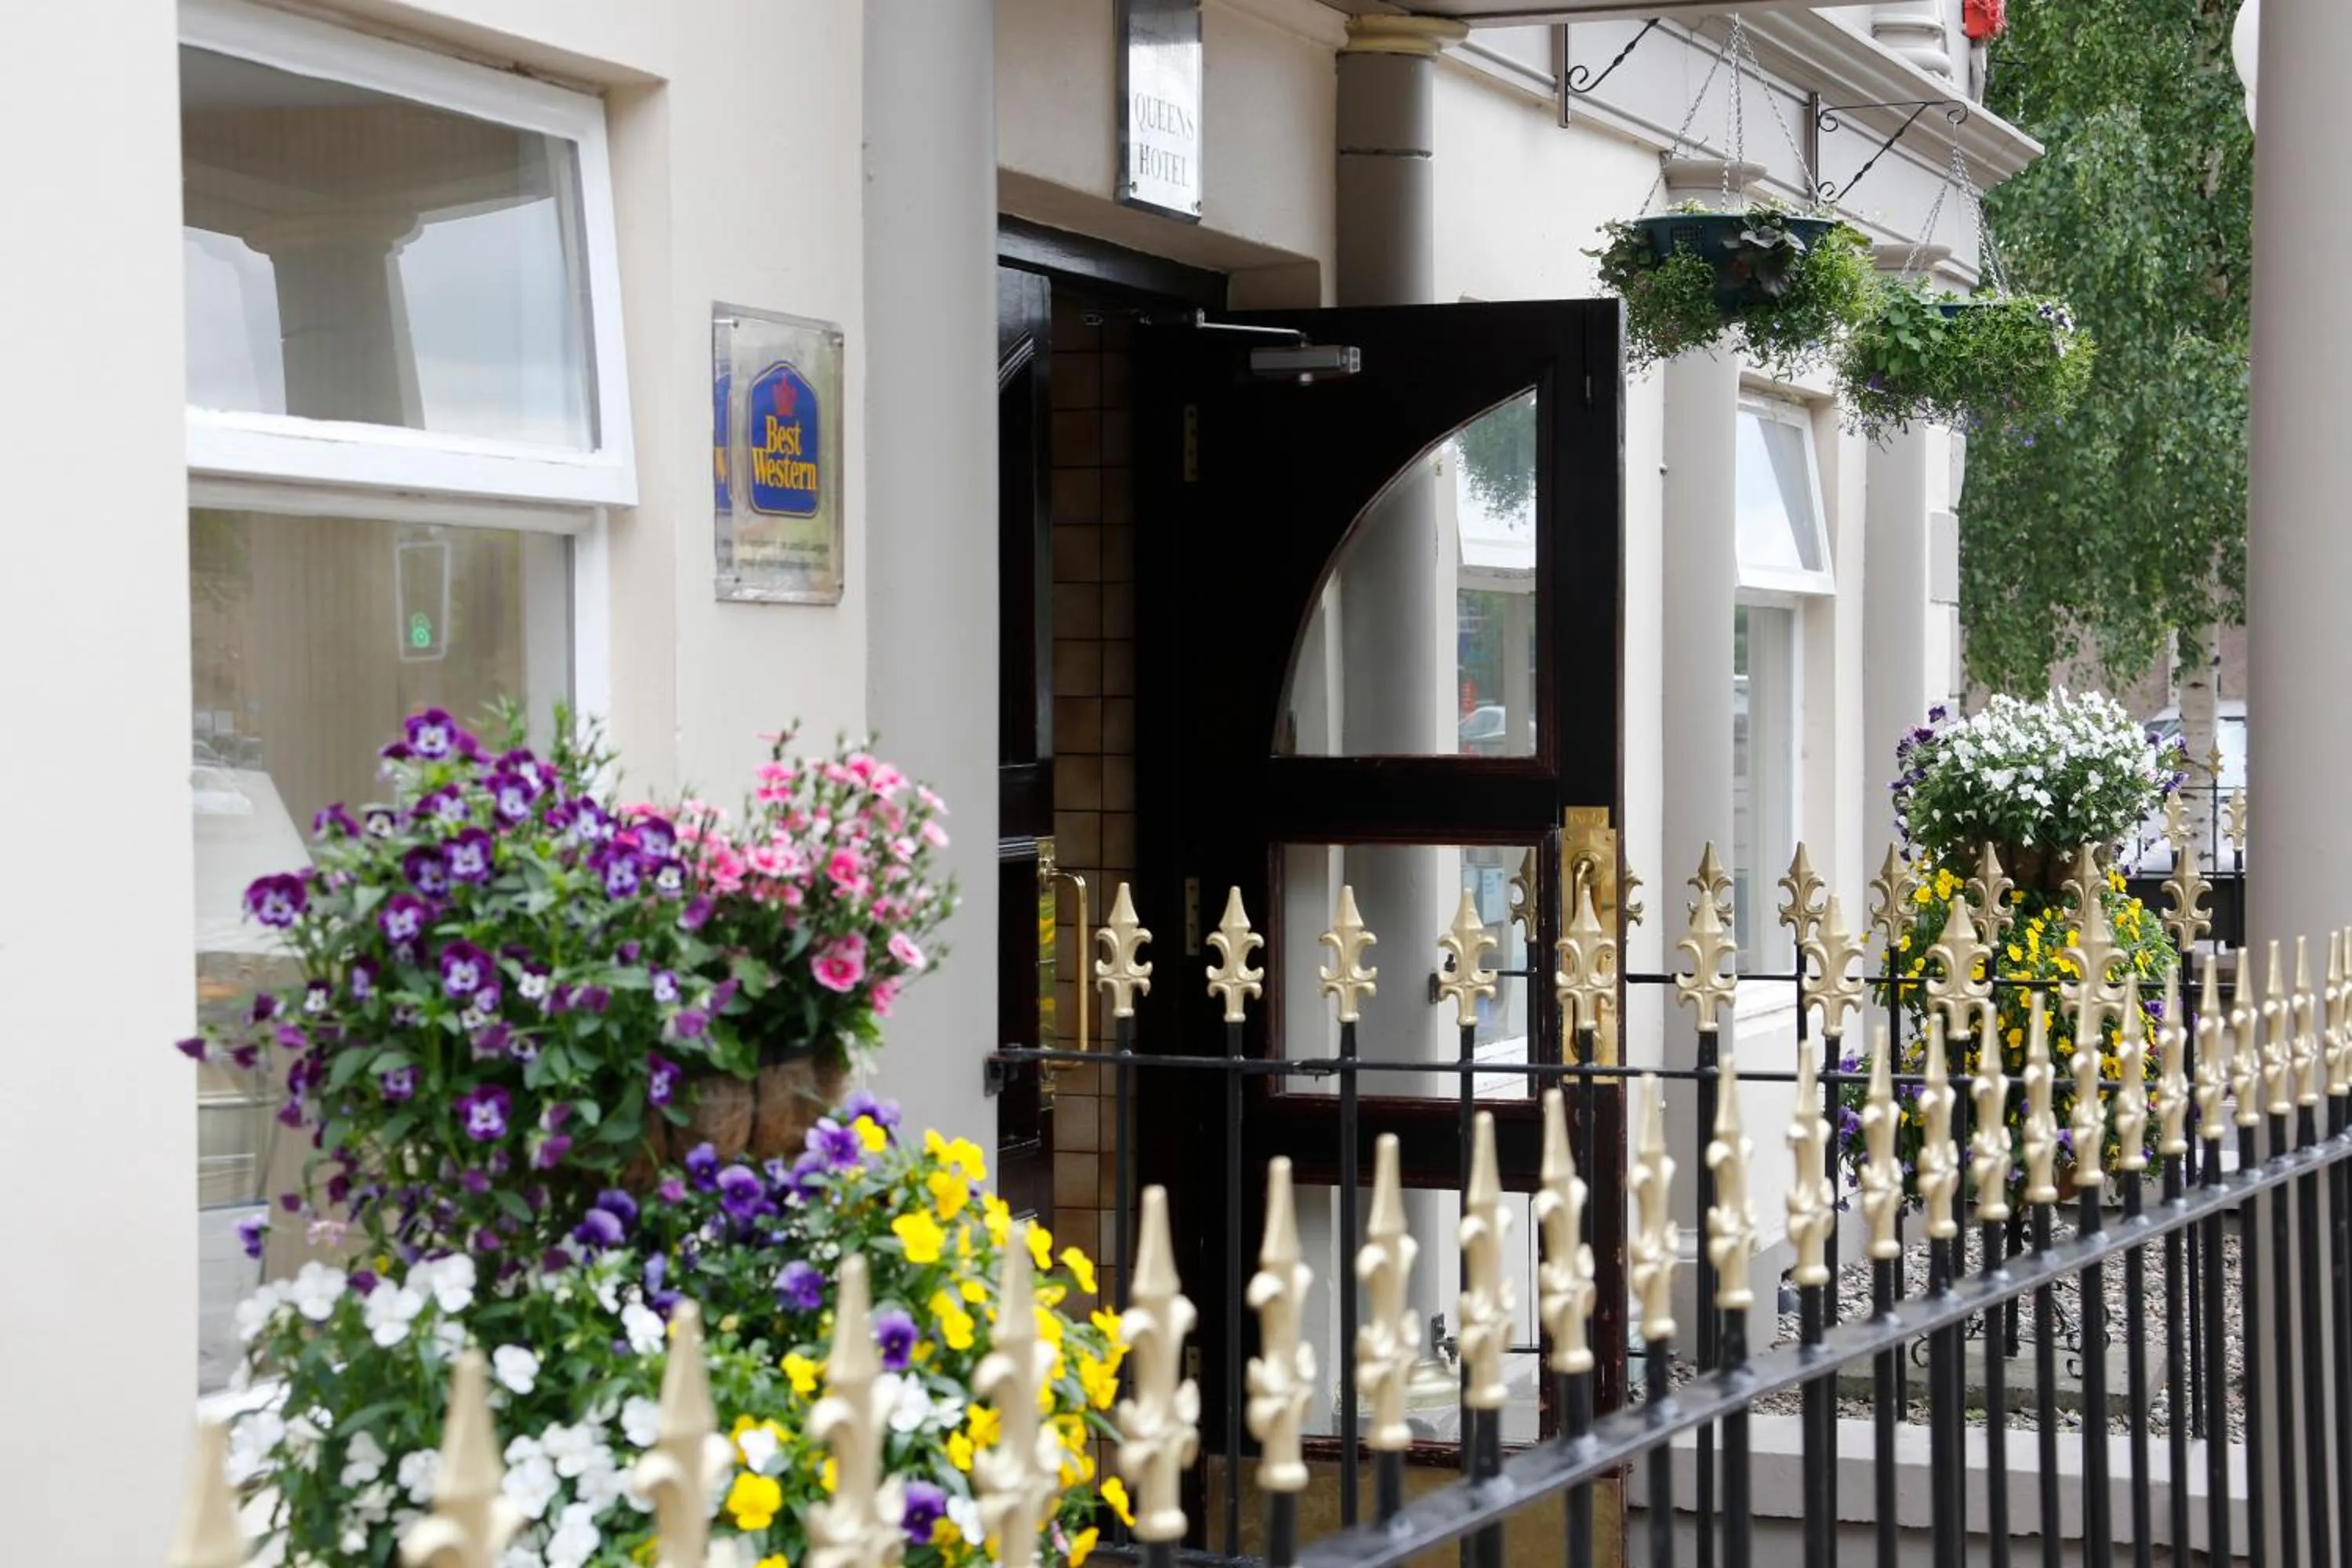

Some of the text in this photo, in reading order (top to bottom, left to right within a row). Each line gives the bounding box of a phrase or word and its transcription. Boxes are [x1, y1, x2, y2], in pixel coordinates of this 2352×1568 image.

[1134, 93, 1194, 140] QUEENS
[1139, 143, 1189, 188] HOTEL
[765, 415, 801, 456] Best
[752, 447, 818, 490] Western
